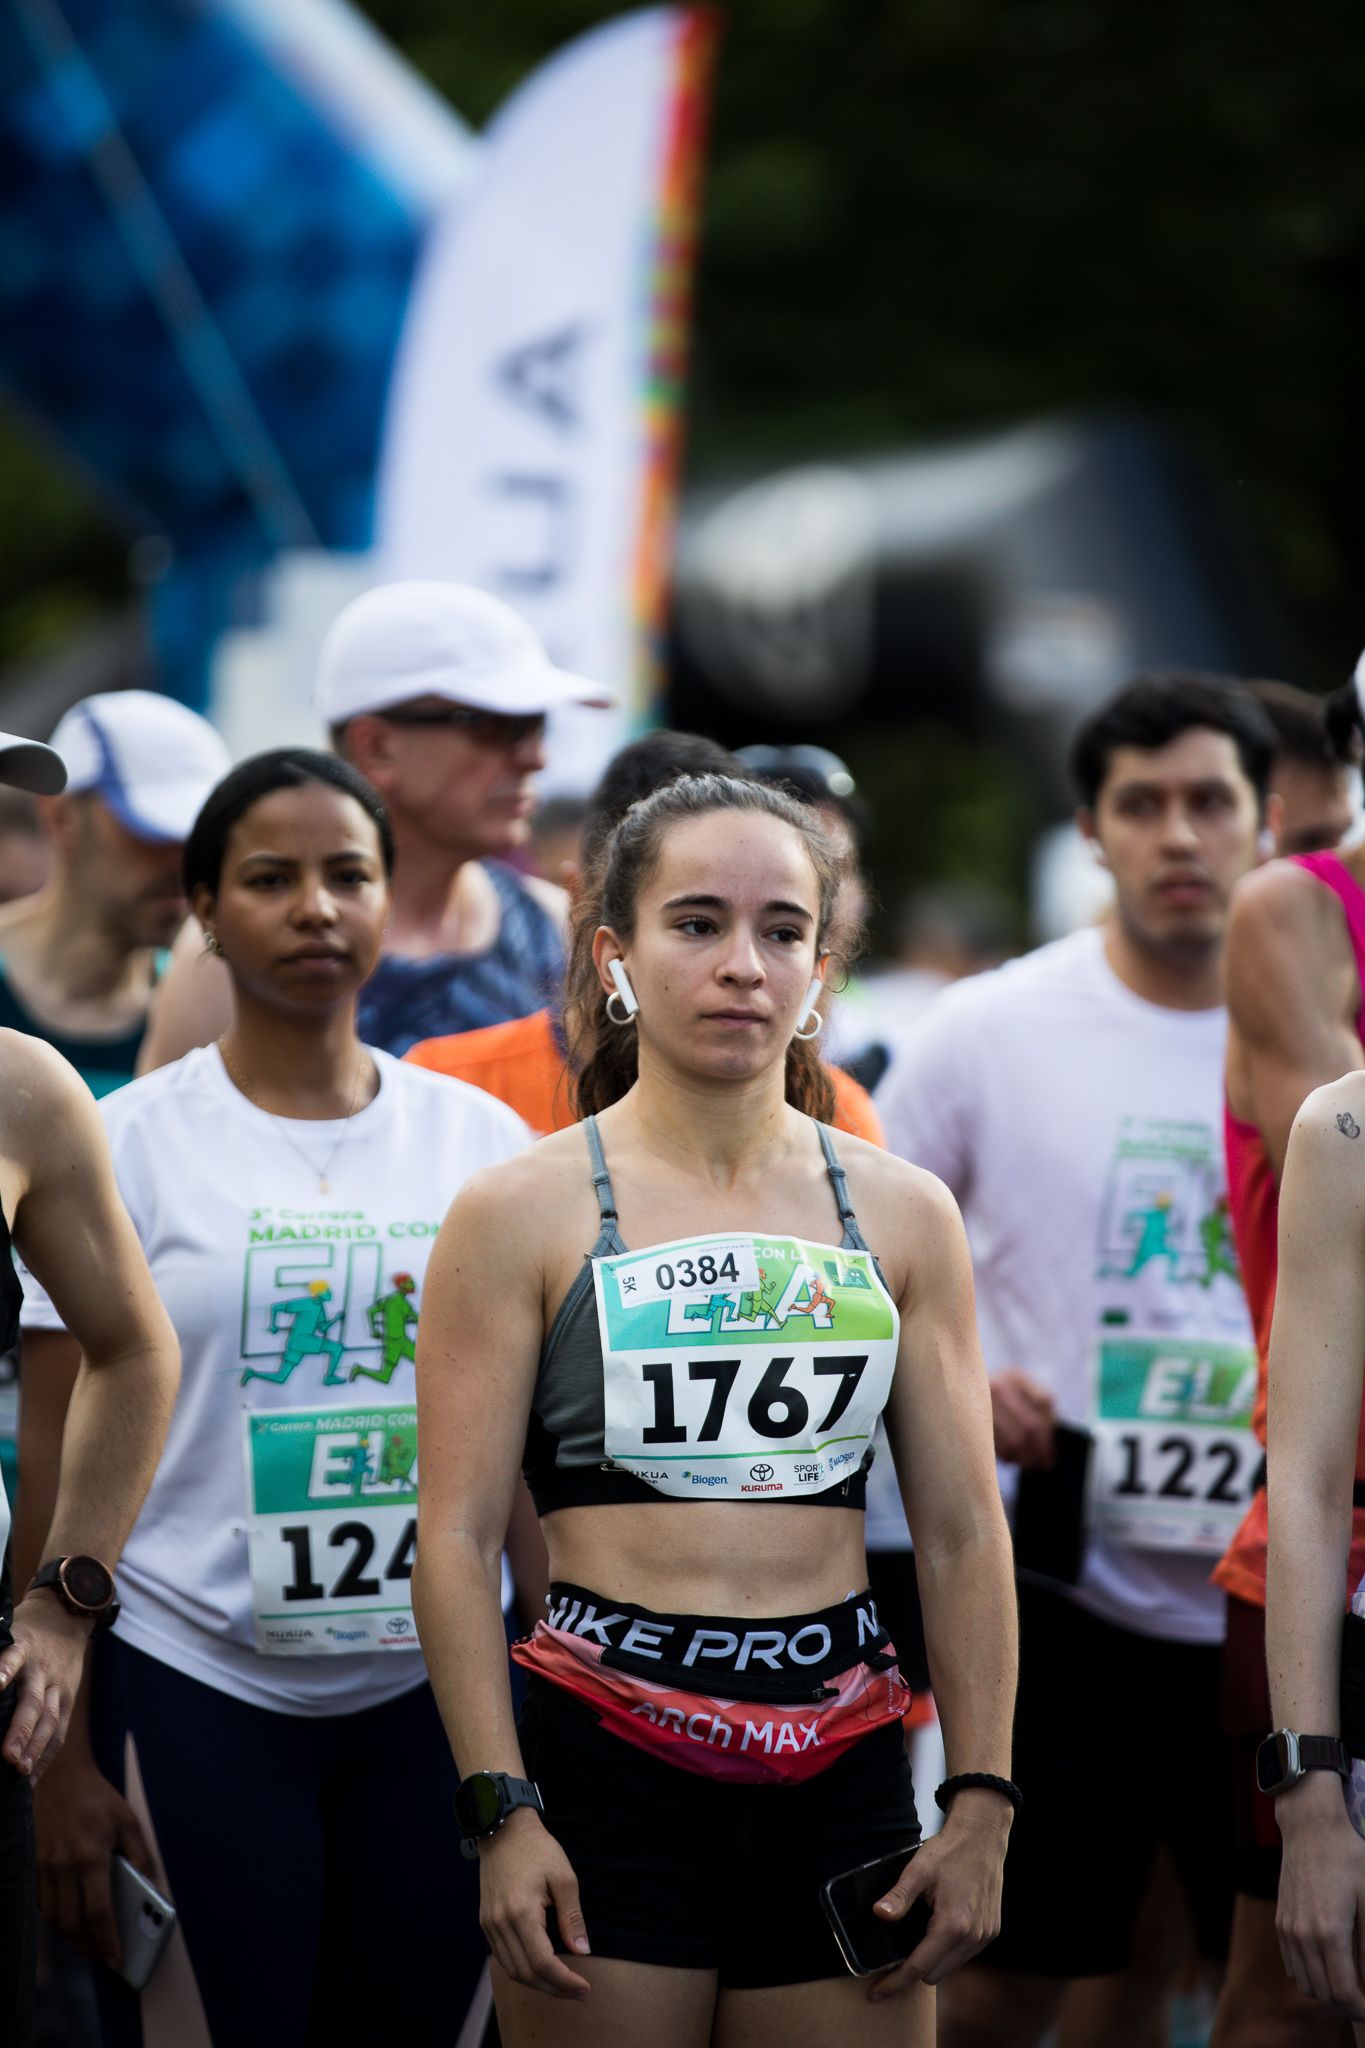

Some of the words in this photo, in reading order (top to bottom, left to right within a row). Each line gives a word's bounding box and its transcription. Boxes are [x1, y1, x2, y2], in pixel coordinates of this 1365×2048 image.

[248, 1222, 377, 1243] MADRID
[753, 1246, 785, 1261] CON
[621, 1276, 637, 1296] 5K
[655, 1251, 740, 1292] 0384
[667, 1263, 834, 1336] ELA
[641, 1355, 869, 1444] 1767
[315, 1414, 385, 1431] MADRID
[691, 1474, 727, 1487] Biogen
[798, 1472, 820, 1482] LIFE
[1116, 1432, 1266, 1504] 122
[544, 1592, 675, 1662] NIKE
[682, 1623, 832, 1671] PRO
[740, 1718, 822, 1755] MAX
